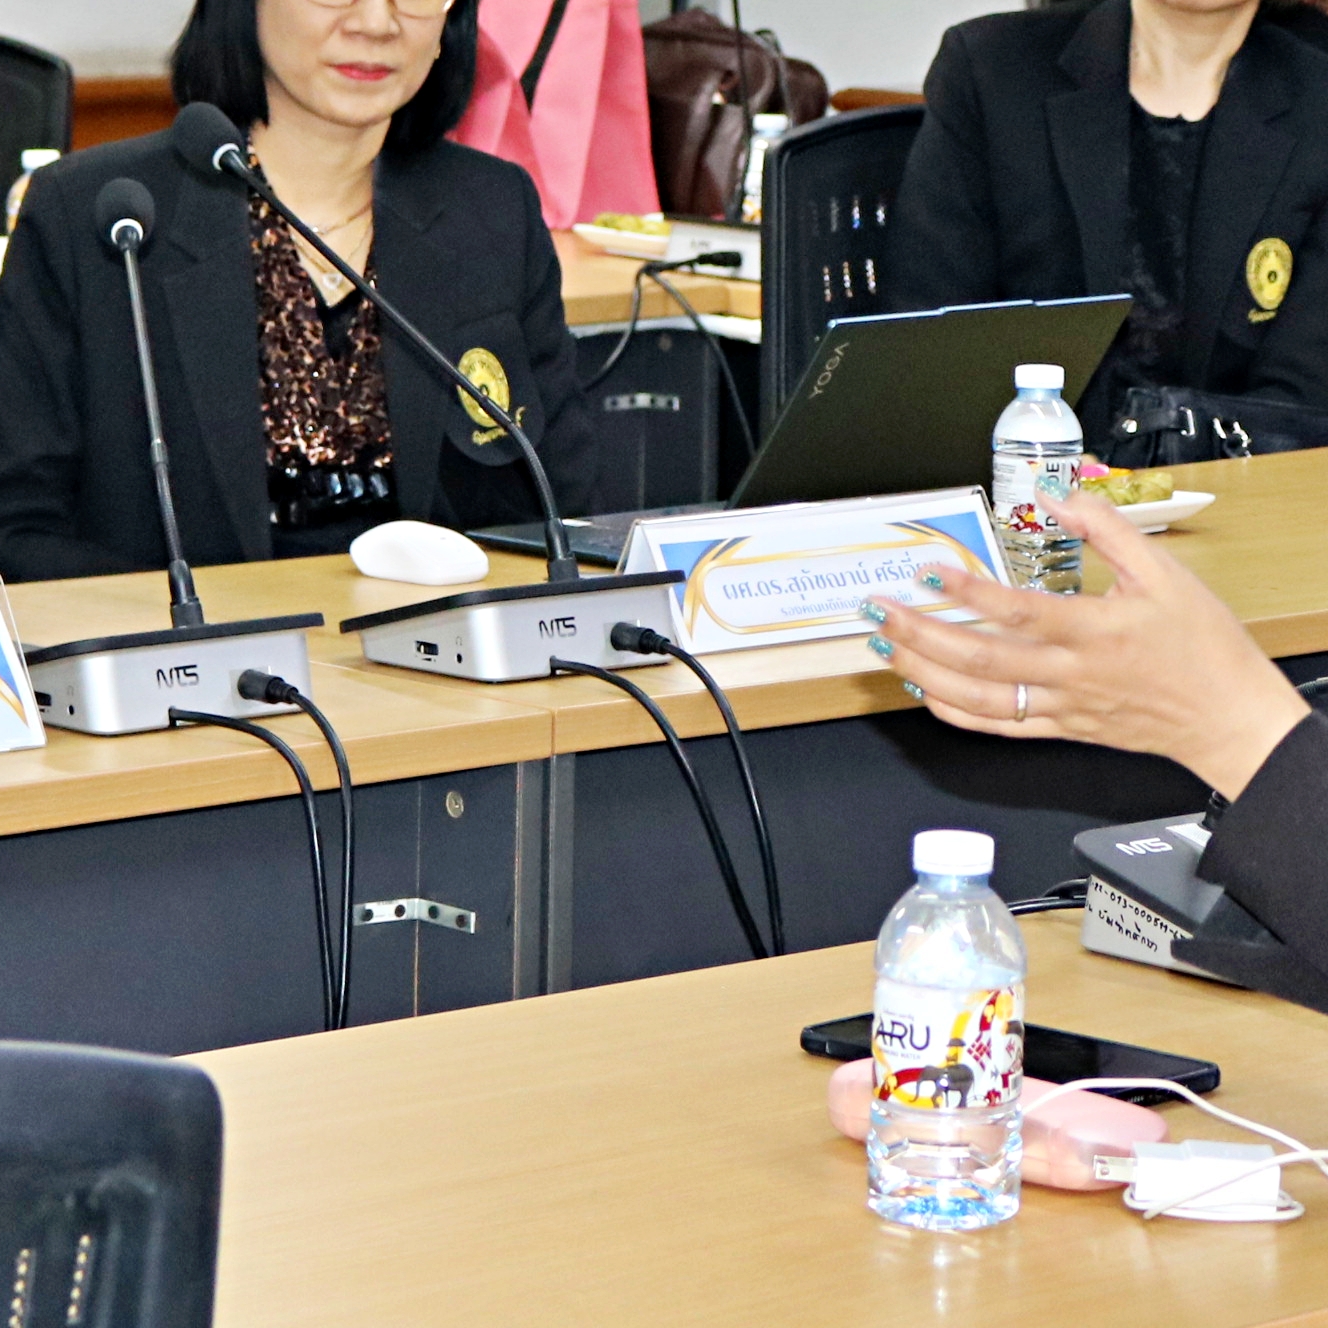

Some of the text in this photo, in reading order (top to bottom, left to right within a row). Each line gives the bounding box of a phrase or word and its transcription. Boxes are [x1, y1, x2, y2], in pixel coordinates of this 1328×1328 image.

[539, 616, 577, 639] NTS
[156, 664, 200, 690] NTS
[1115, 837, 1173, 856] NTS
[875, 1015, 931, 1051] ARU
